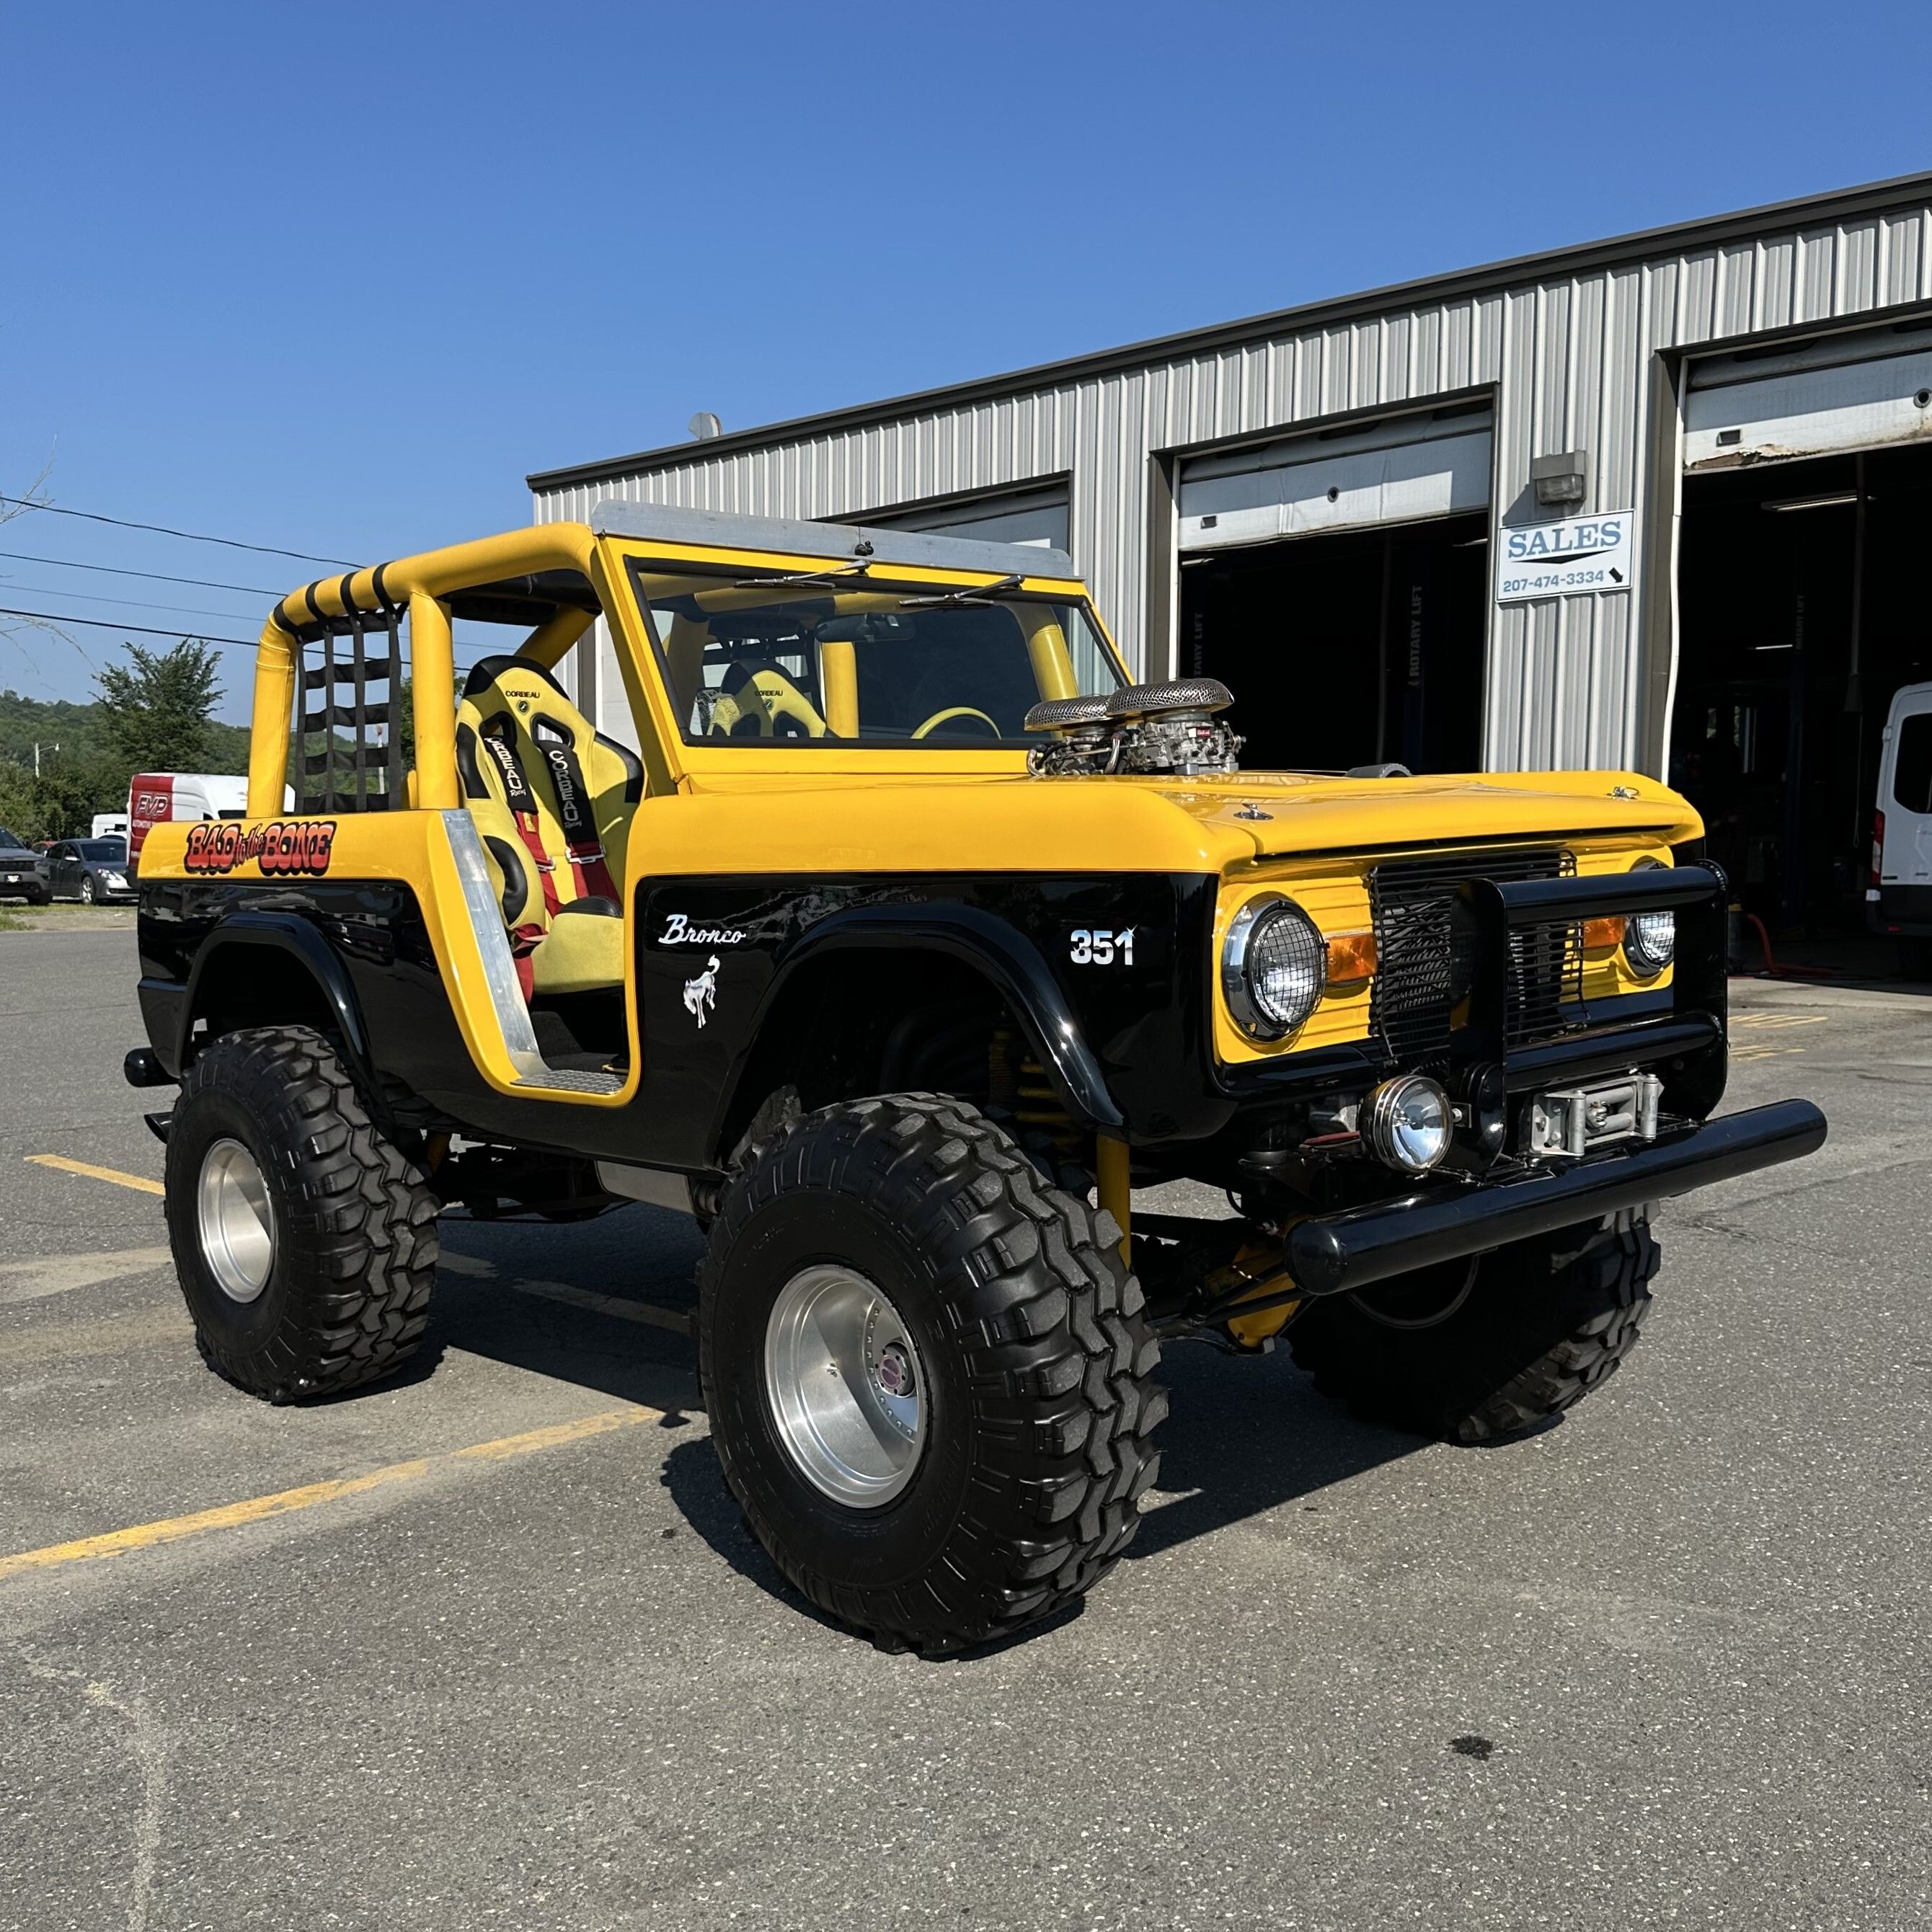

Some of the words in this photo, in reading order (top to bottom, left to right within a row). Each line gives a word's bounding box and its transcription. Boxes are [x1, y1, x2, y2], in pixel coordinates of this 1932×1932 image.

[1508, 520, 1621, 558] SALES
[1503, 570, 1604, 592] 207-474-3334
[484, 737, 523, 789] ORBEAU
[549, 750, 579, 821] CORBEAU
[185, 824, 241, 875] BAD
[258, 821, 337, 877] BONE
[658, 914, 746, 944] Bronco
[1071, 929, 1135, 965] 351
